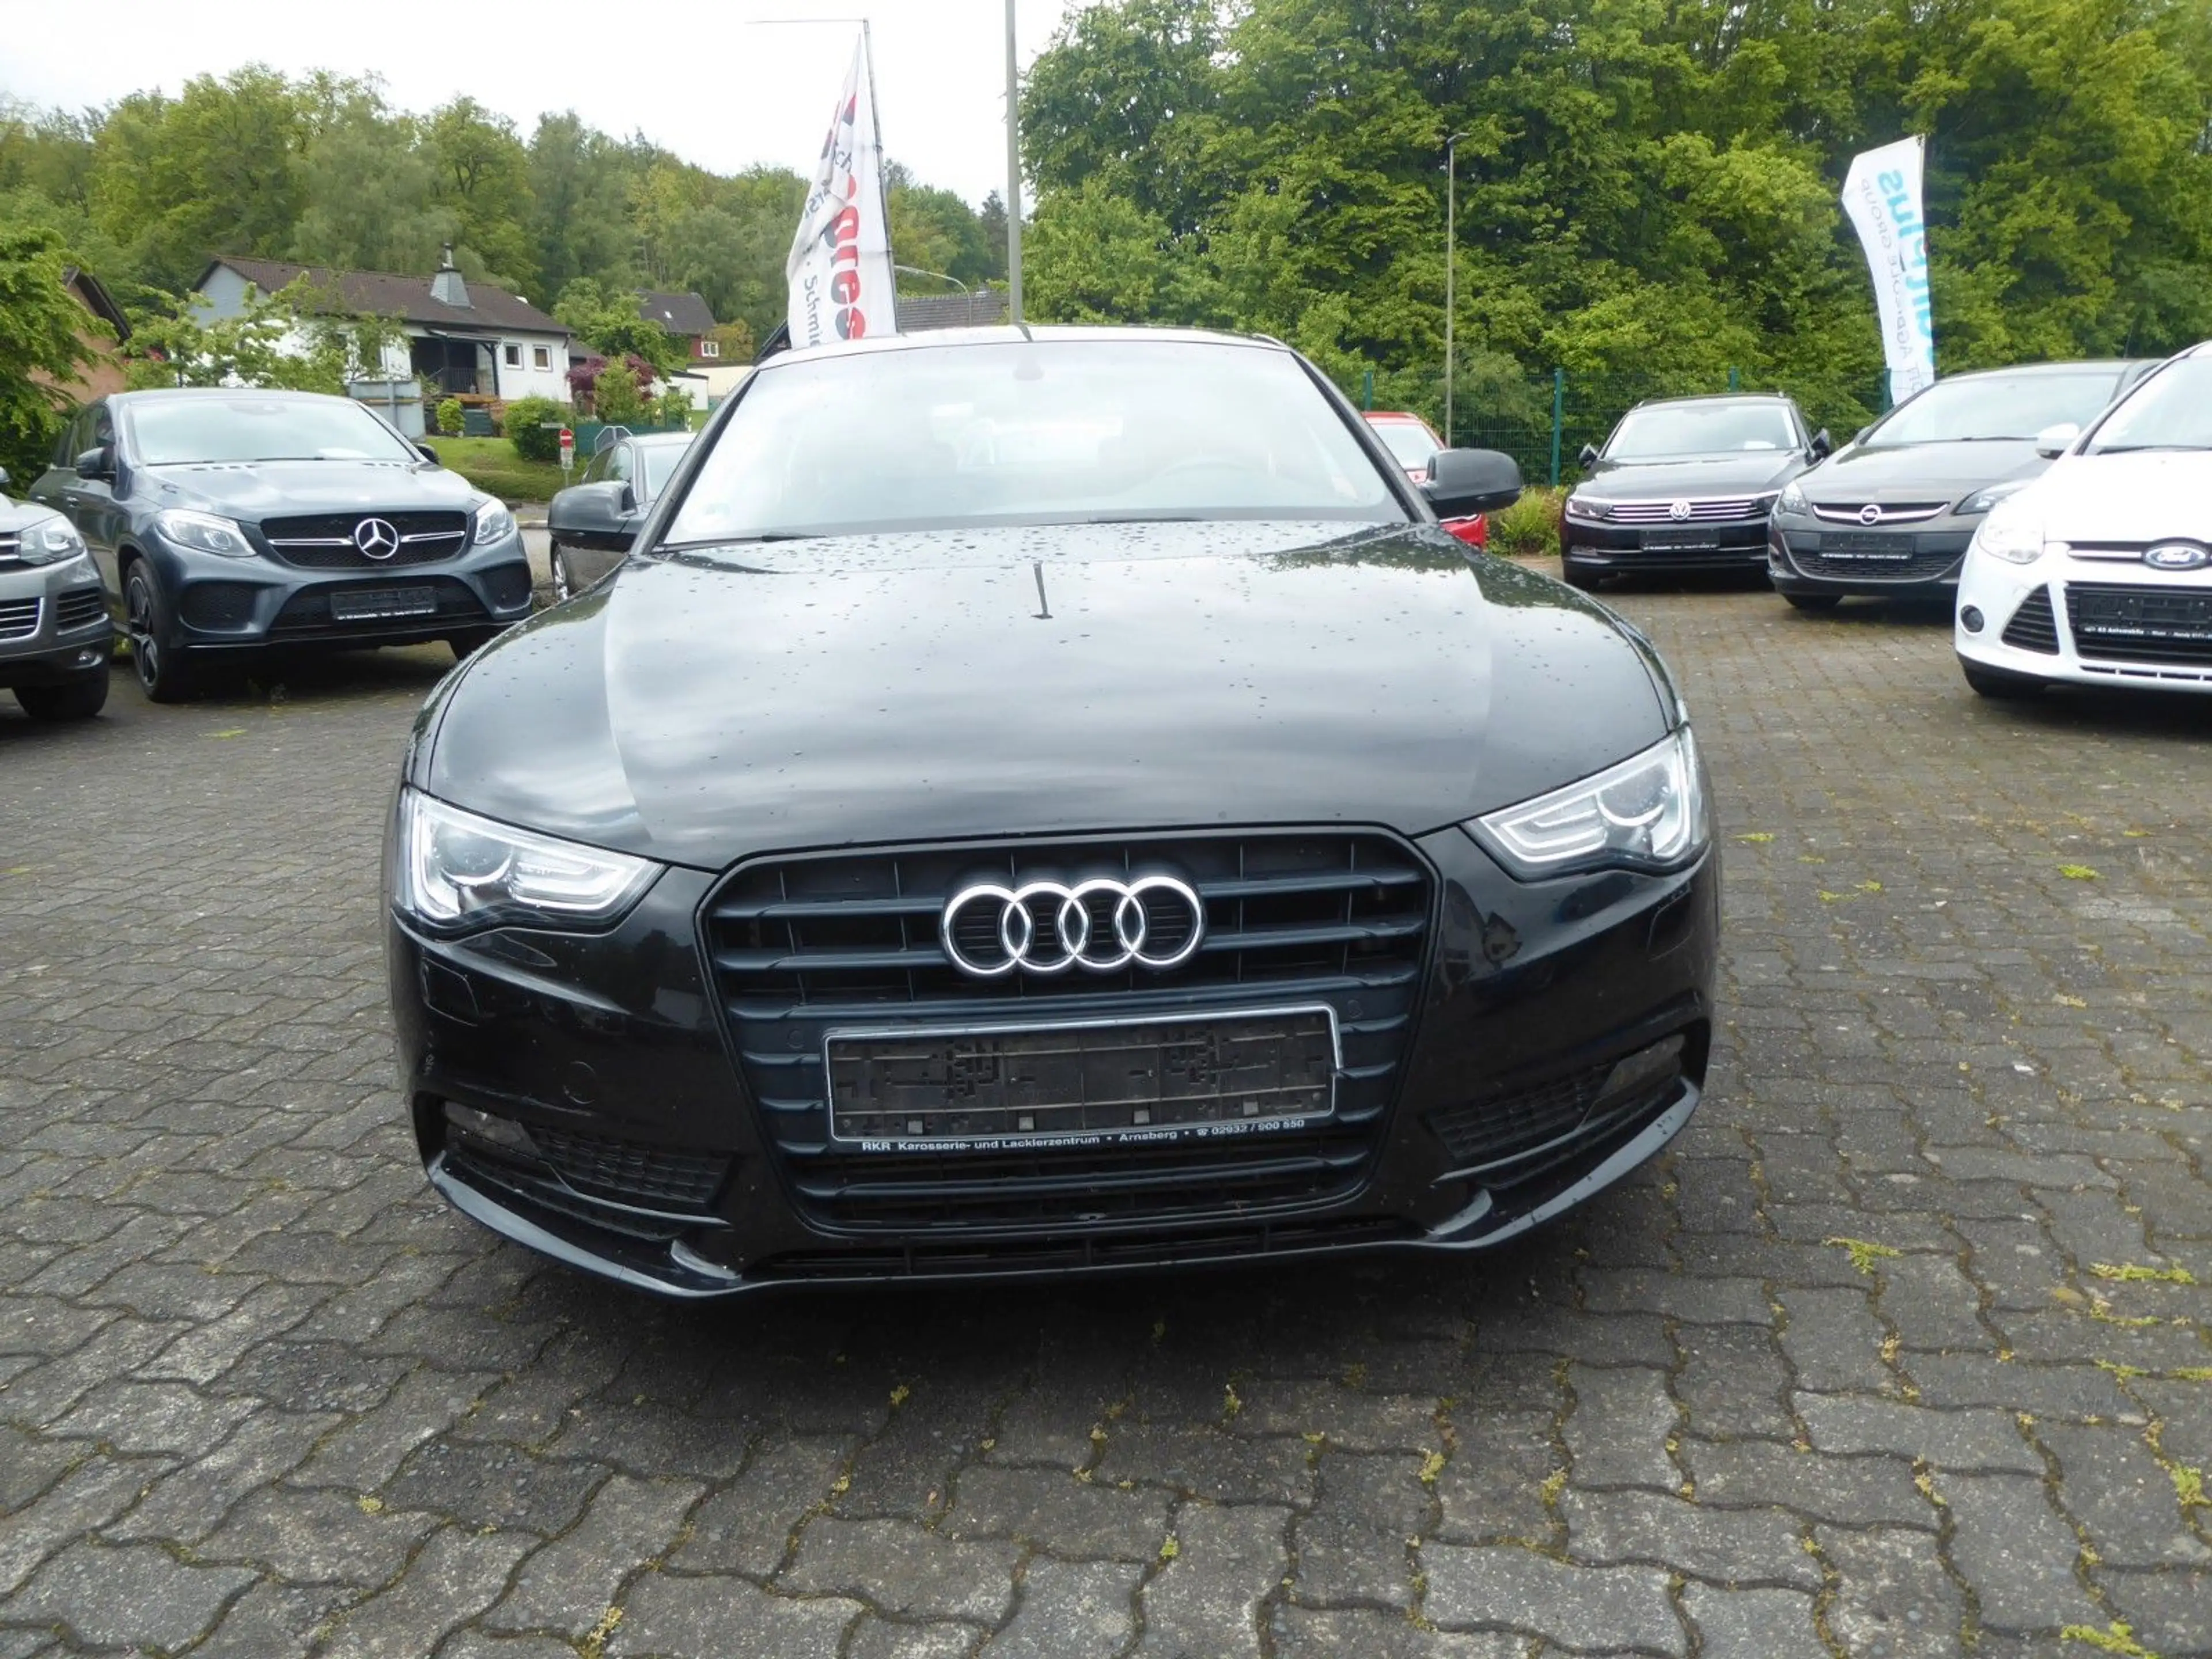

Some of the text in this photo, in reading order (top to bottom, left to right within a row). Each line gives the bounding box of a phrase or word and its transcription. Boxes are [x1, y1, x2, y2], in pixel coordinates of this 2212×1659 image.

[862, 1142, 891, 1150] RKR
[898, 1141, 970, 1150] Karosserie-
[974, 1140, 998, 1149] und
[1002, 1135, 1100, 1148] Lackierzentrum
[1119, 1130, 1177, 1142] Arnsberg
